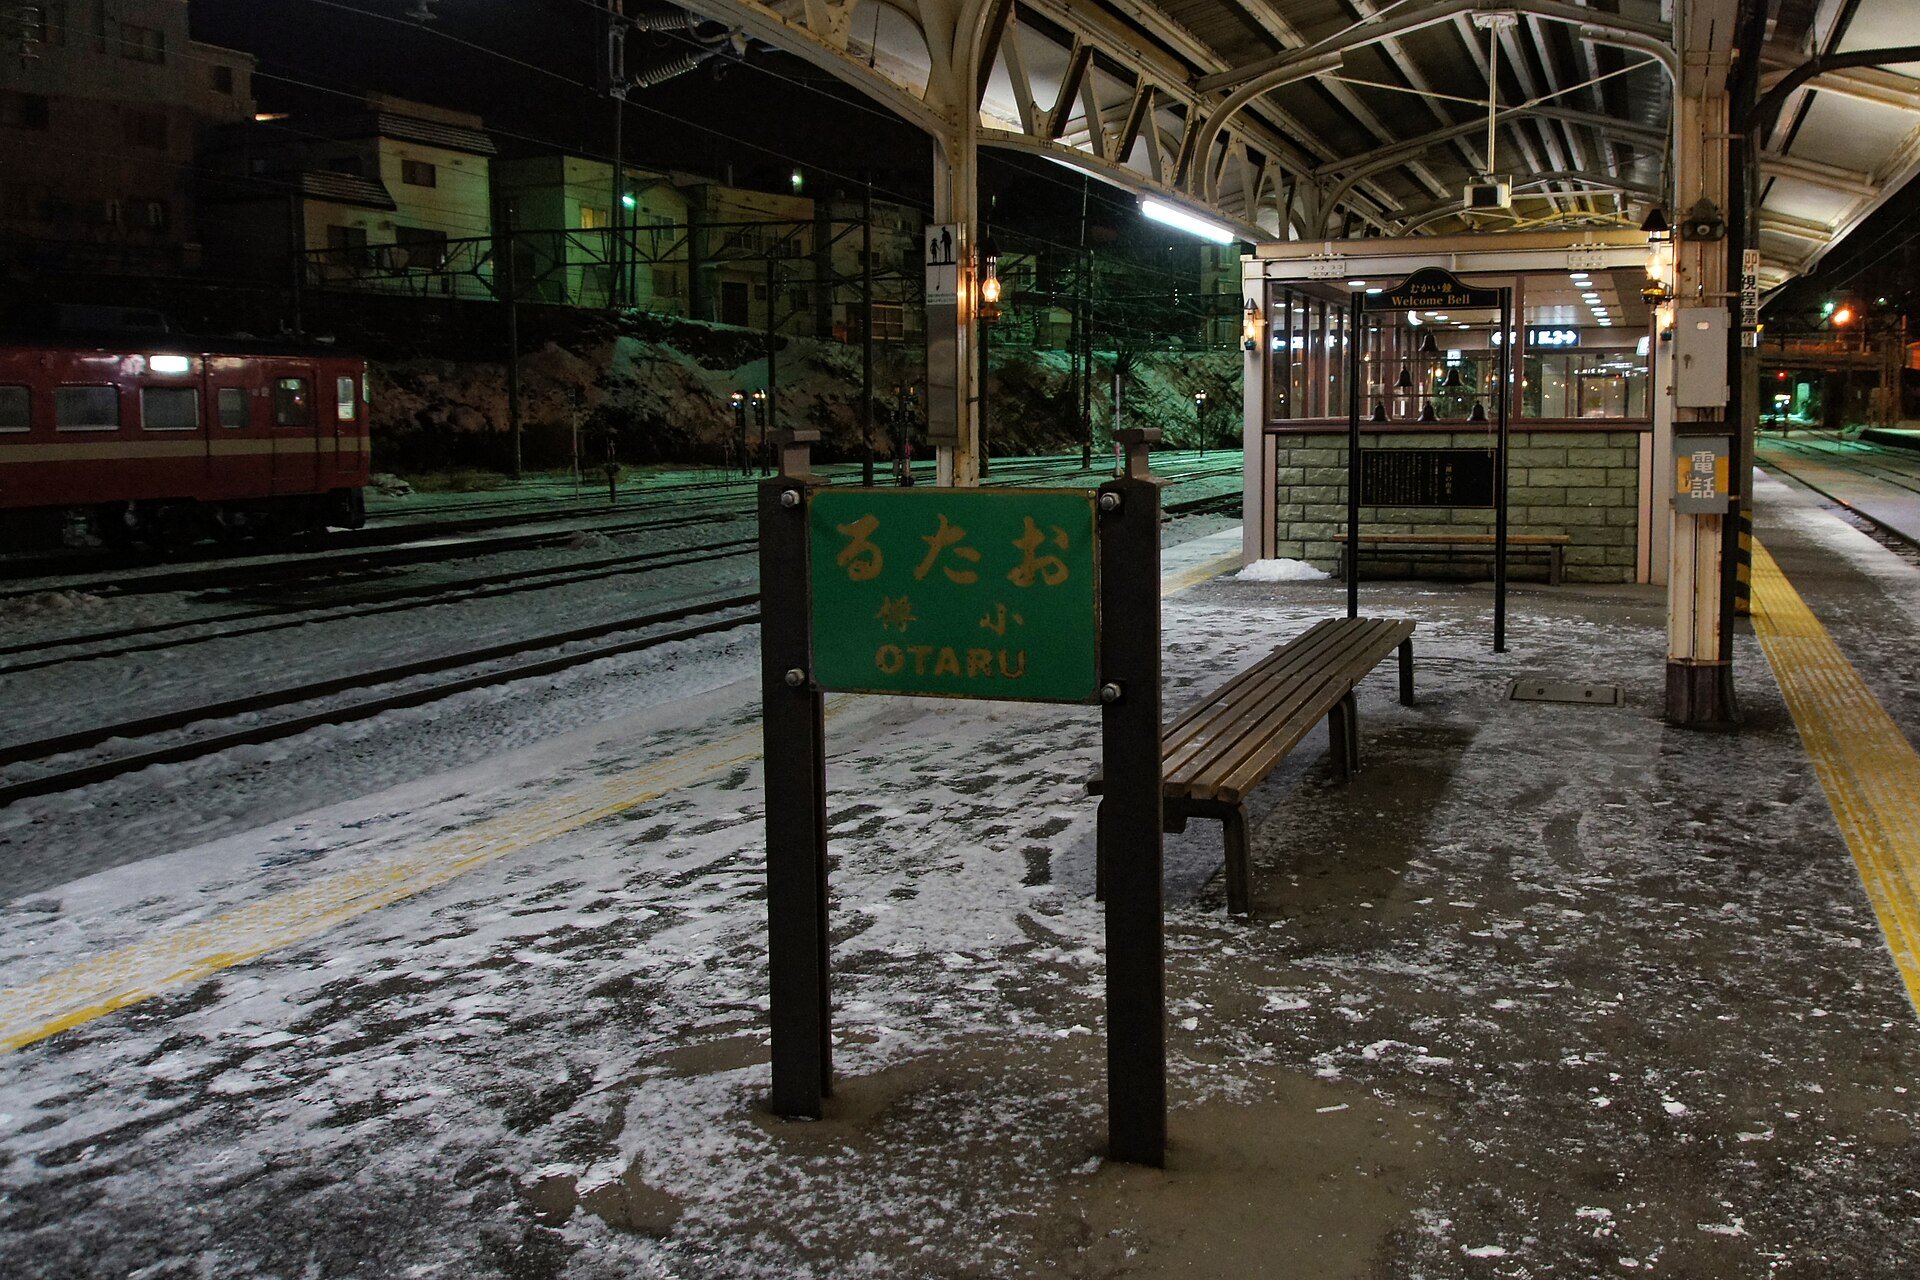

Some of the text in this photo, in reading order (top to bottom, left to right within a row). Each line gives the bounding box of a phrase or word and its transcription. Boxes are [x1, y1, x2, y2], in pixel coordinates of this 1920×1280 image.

[1392, 294, 1470, 306] Welcome Bell
[1691, 450, 1715, 499] 電話
[875, 644, 1027, 679] OTARU
